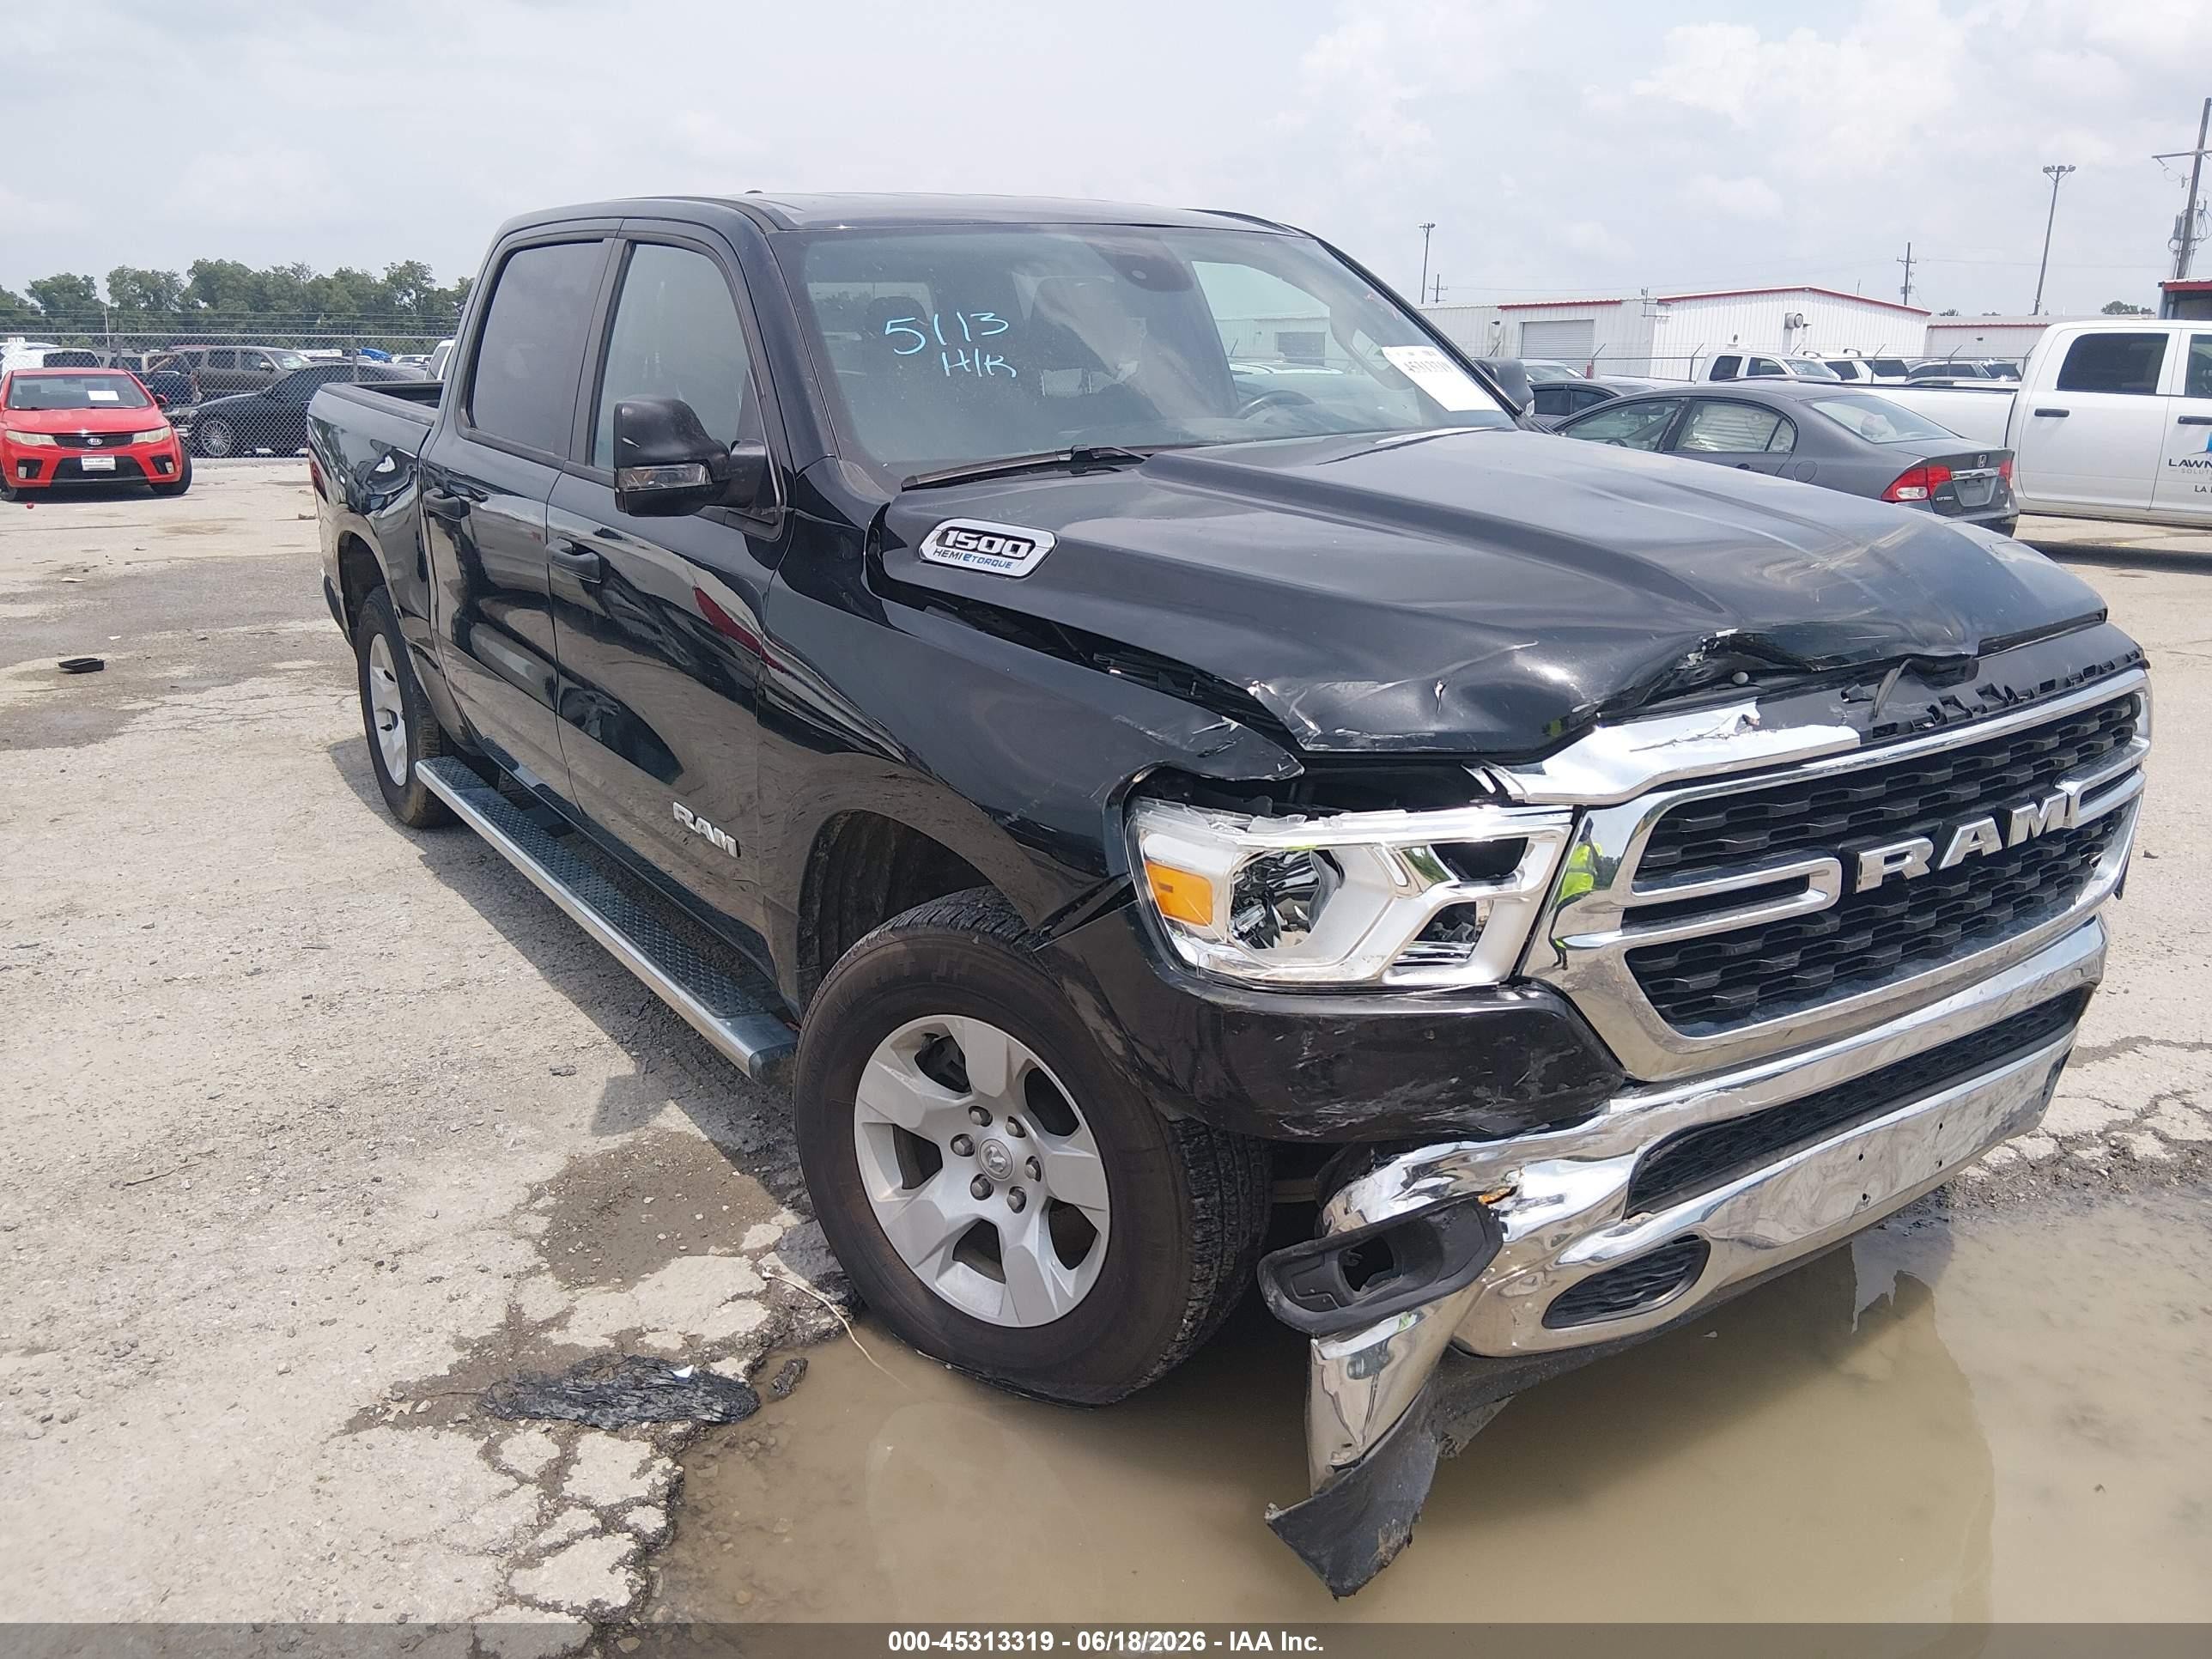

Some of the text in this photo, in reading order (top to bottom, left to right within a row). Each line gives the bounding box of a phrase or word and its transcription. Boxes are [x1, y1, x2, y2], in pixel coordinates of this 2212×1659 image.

[884, 312, 1010, 355] 5113
[933, 549, 962, 561] HEMI
[944, 530, 1032, 558] 1500
[673, 801, 739, 858] RAM
[1854, 792, 2067, 894] RAM
